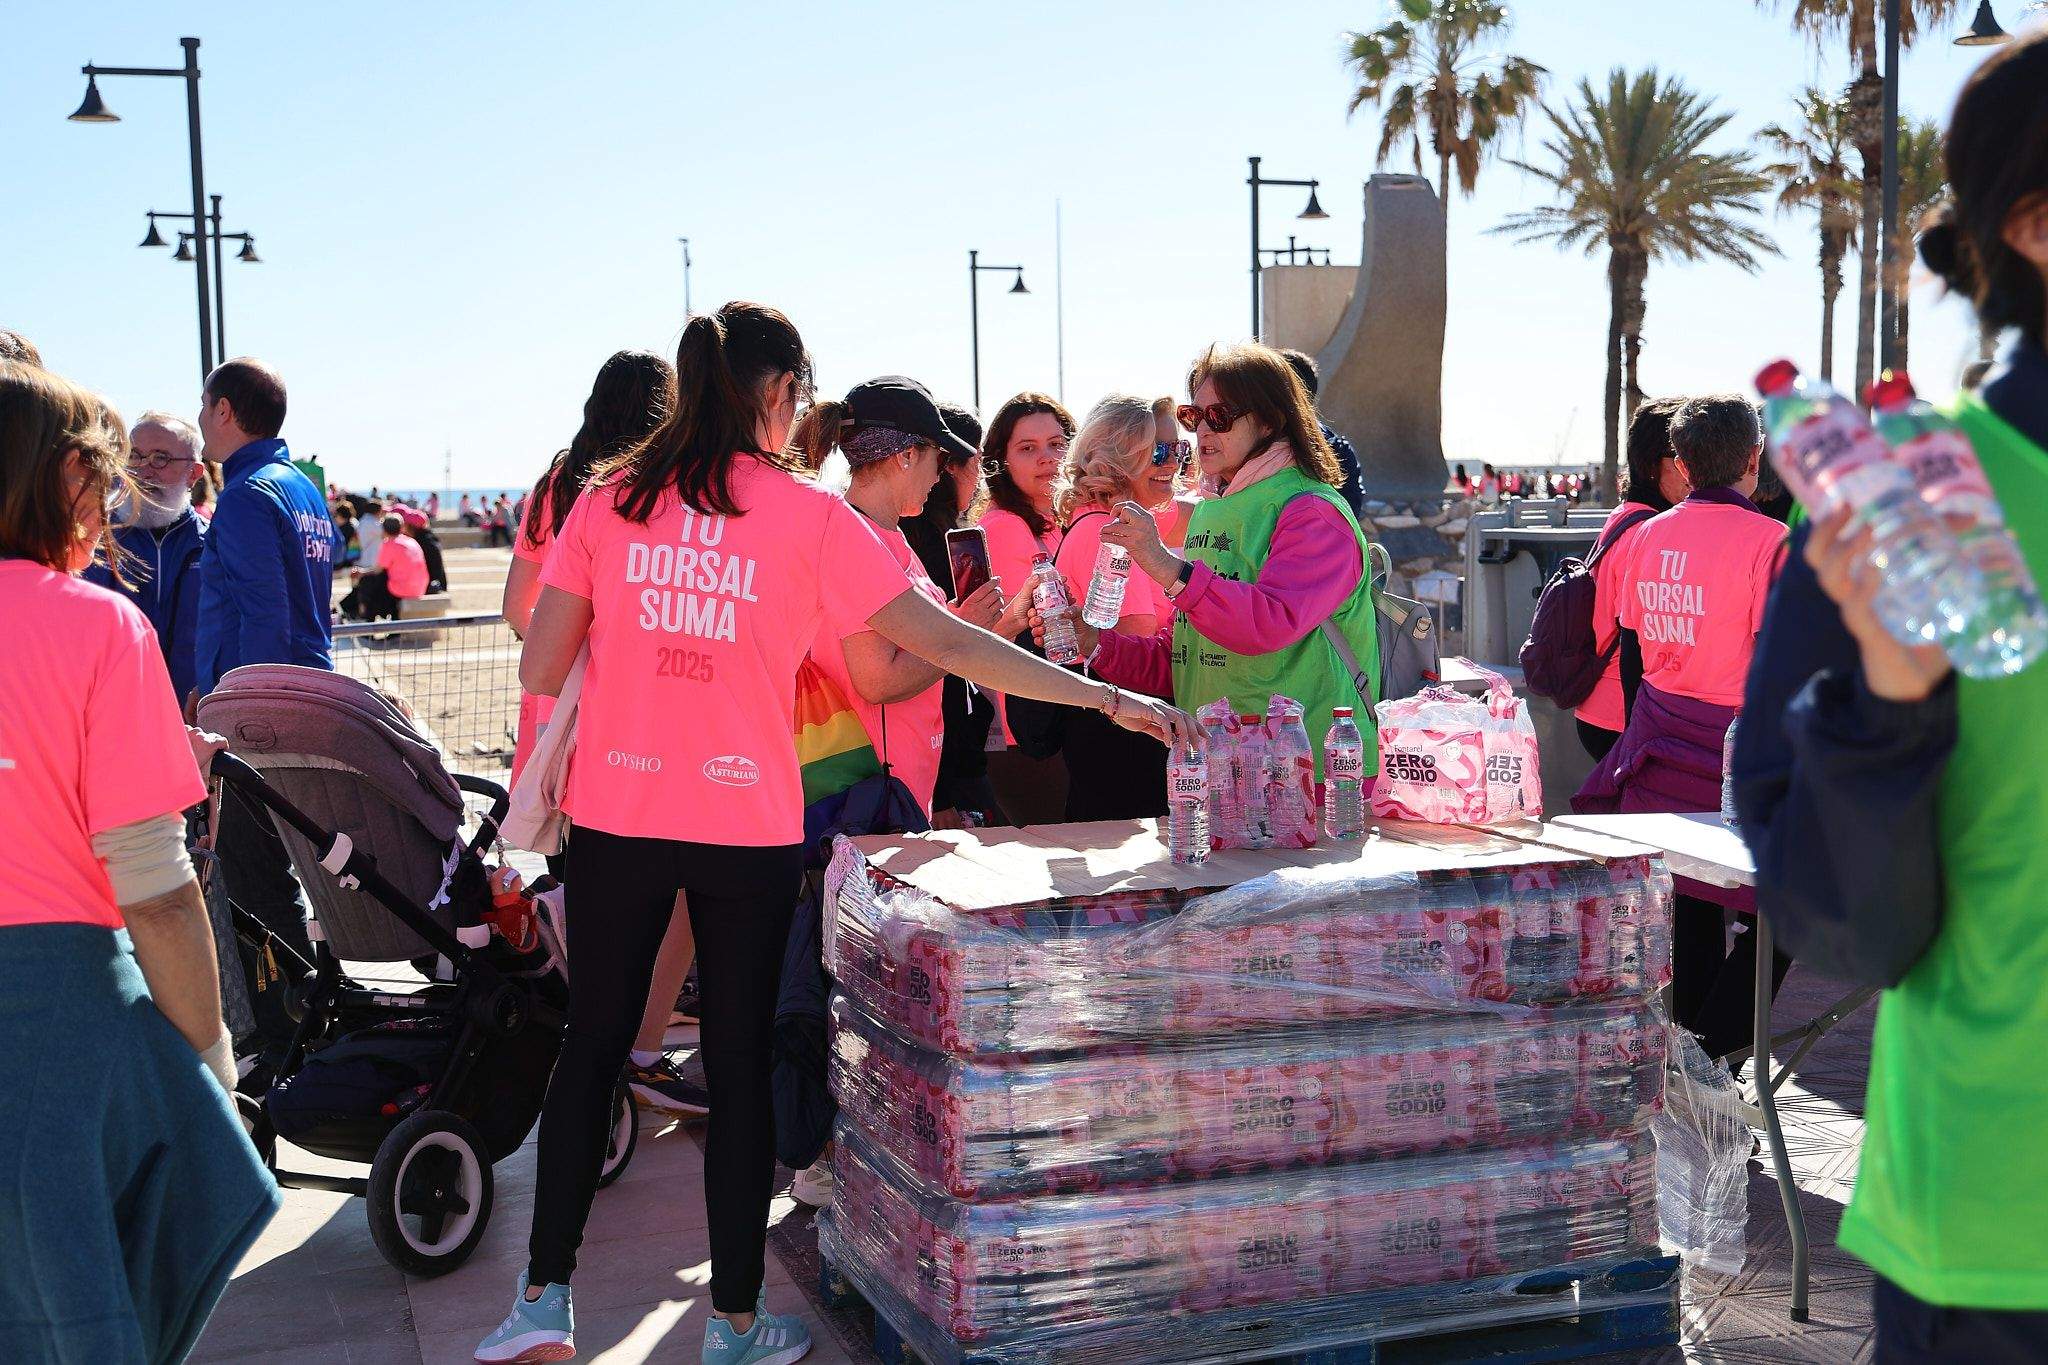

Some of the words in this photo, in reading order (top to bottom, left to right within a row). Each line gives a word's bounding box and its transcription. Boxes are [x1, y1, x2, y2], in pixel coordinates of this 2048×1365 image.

[680, 503, 726, 547] TU
[625, 542, 759, 603] DORSAL
[1660, 549, 1687, 581] TU
[639, 588, 737, 643] SUMA
[656, 646, 714, 683] 2025
[1657, 651, 1682, 673] 25
[607, 750, 662, 772] OYSHO
[1385, 754, 1436, 769] ZERO
[1386, 768, 1438, 783] SODIO
[1231, 953, 1293, 974] ZERO
[1386, 1081, 1445, 1099] ZERO
[1232, 1095, 1294, 1114] ZERO
[1385, 1098, 1446, 1117] SODIO
[1232, 1112, 1296, 1131] SODIO
[1383, 1217, 1441, 1234] ZERO
[1238, 1232, 1299, 1251] ZERO
[1380, 1233, 1442, 1251] SODIO
[998, 1247, 1024, 1256] ZERO
[1236, 1249, 1299, 1270] SODIO
